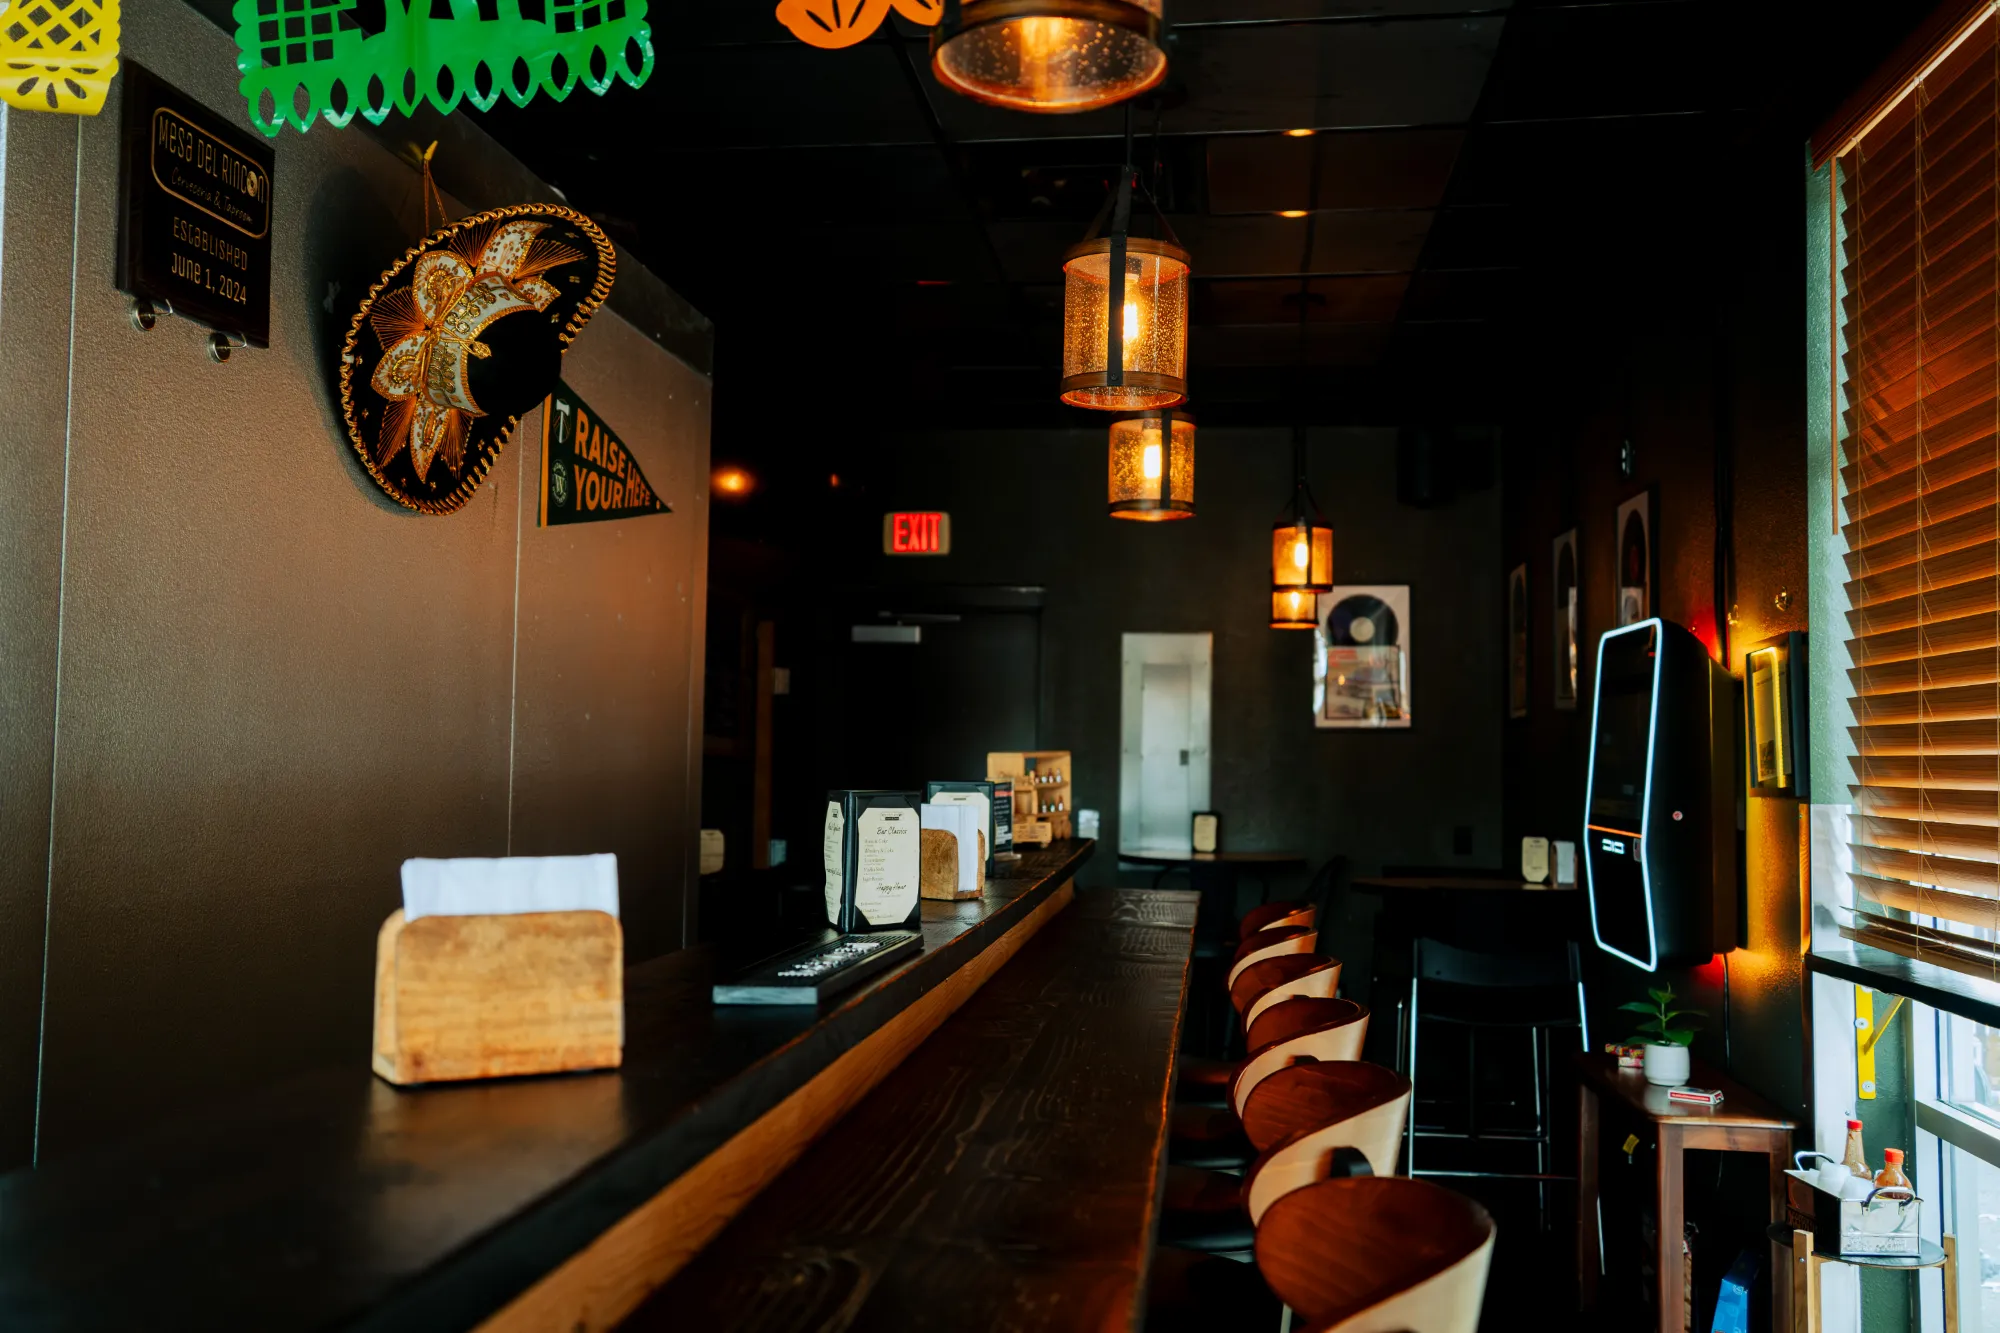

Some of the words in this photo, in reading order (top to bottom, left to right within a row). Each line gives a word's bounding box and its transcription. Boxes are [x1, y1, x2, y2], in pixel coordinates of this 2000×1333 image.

[219, 274, 247, 305] 2024
[574, 407, 627, 479] RAISE
[573, 463, 624, 511] YOUR
[893, 512, 943, 553] EXIT
